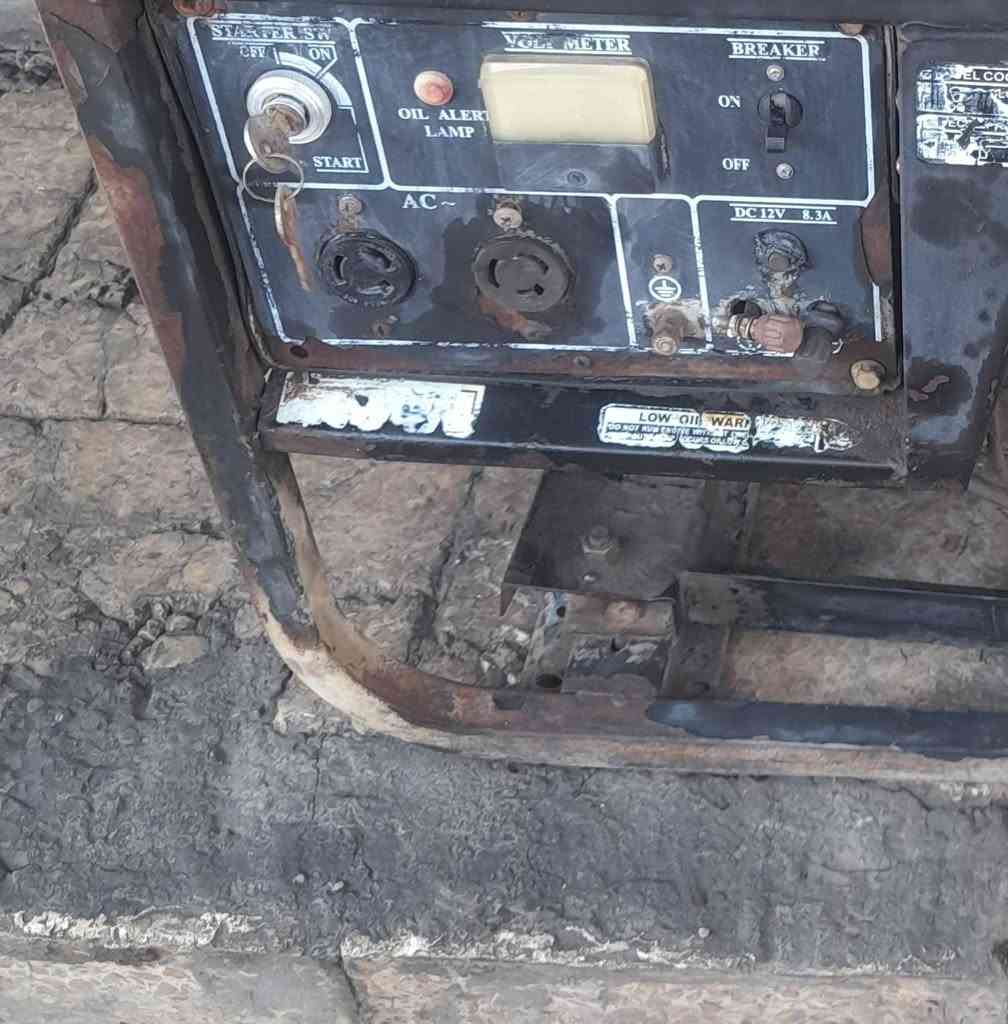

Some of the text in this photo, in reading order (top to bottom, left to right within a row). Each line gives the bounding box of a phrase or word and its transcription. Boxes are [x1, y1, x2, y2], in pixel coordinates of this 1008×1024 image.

[564, 36, 631, 52] METER
[731, 41, 821, 58] BREAKER
[308, 48, 332, 60] ON
[718, 95, 741, 109] ON
[398, 108, 430, 120] OIL
[424, 125, 475, 139] LAMP
[313, 155, 363, 169] START
[722, 157, 750, 171] OFF
[734, 206, 833, 221] DC 12V 8.3A
[638, 412, 672, 424] LOW
